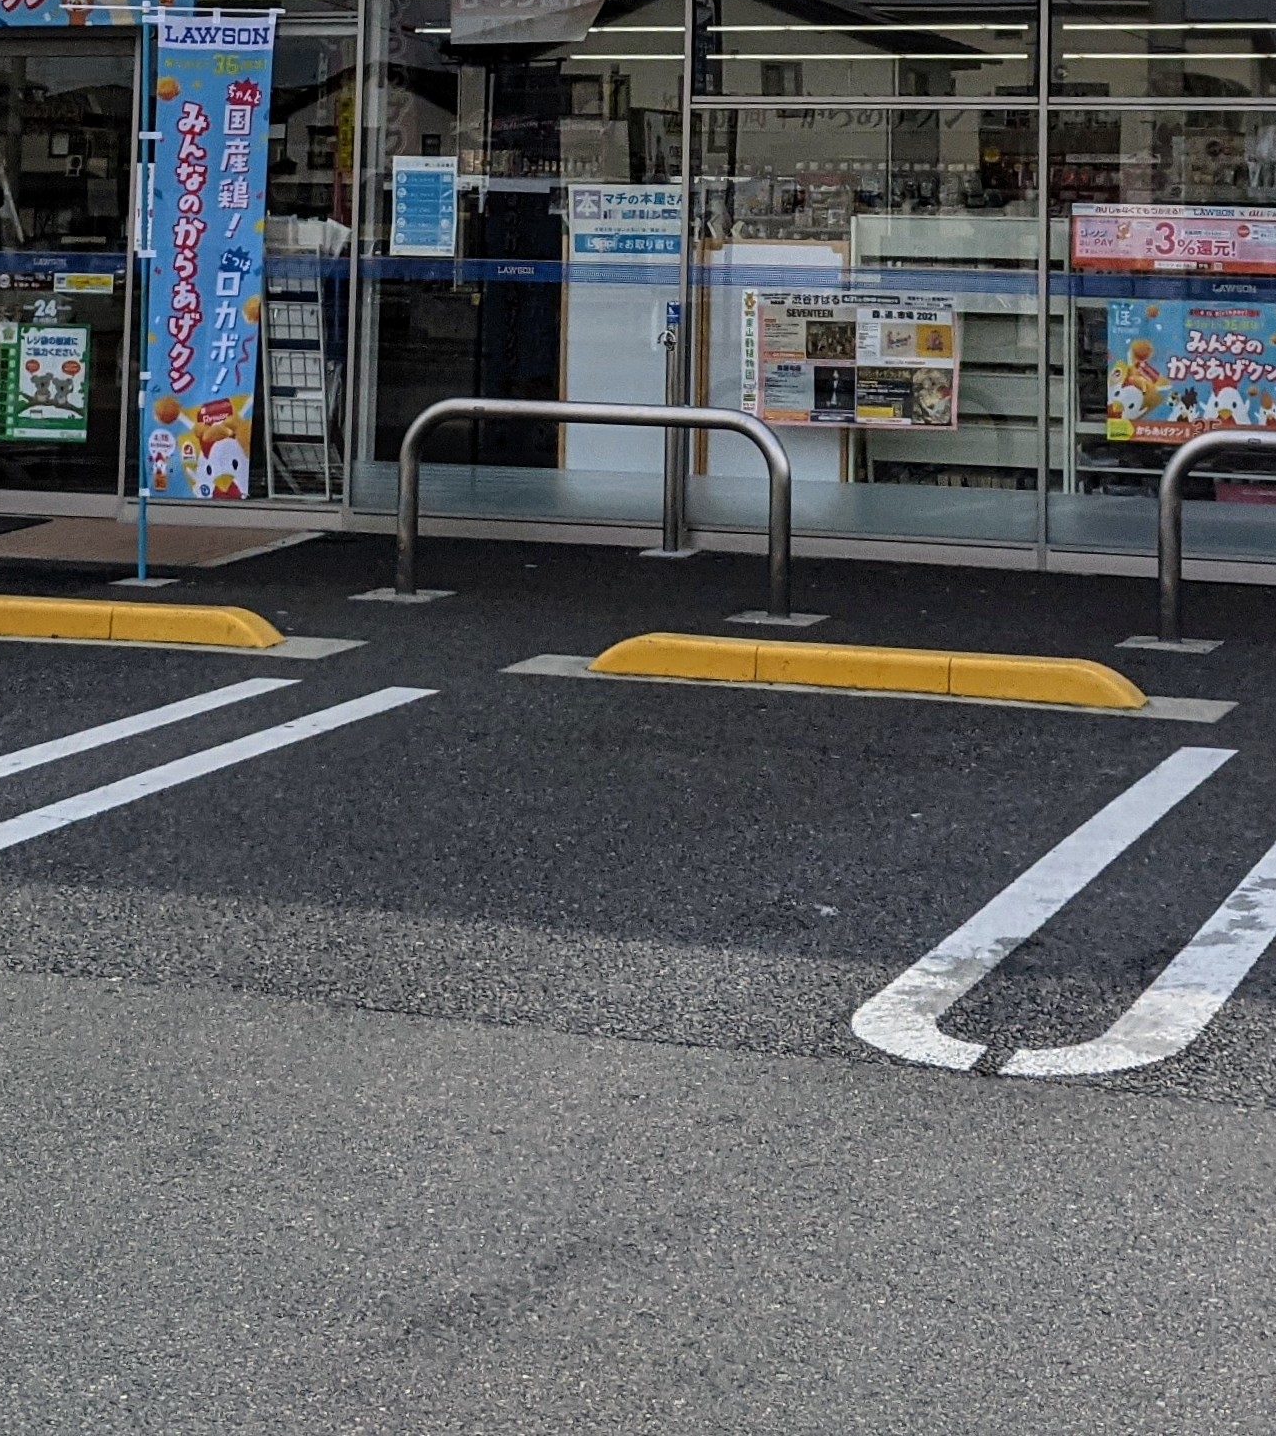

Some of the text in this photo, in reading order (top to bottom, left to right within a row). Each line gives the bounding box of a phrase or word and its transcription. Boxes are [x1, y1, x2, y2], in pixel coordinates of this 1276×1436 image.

[165, 25, 270, 45] LAWSON
[227, 84, 262, 104] ちゃんと
[575, 192, 599, 216] 本
[1193, 208, 1235, 216] LAWSON
[168, 101, 210, 394] みんなのからあげクン
[1094, 238, 1113, 246] PAY
[221, 252, 251, 272] じつは
[497, 266, 535, 275] LAWSON
[1212, 284, 1257, 294] LAWSON
[34, 299, 57, 317] 24
[786, 308, 834, 318] SEVENTEEN
[916, 312, 938, 321] 2021
[1186, 330, 1263, 355] みんなの
[1136, 425, 1183, 437] からあげクン
